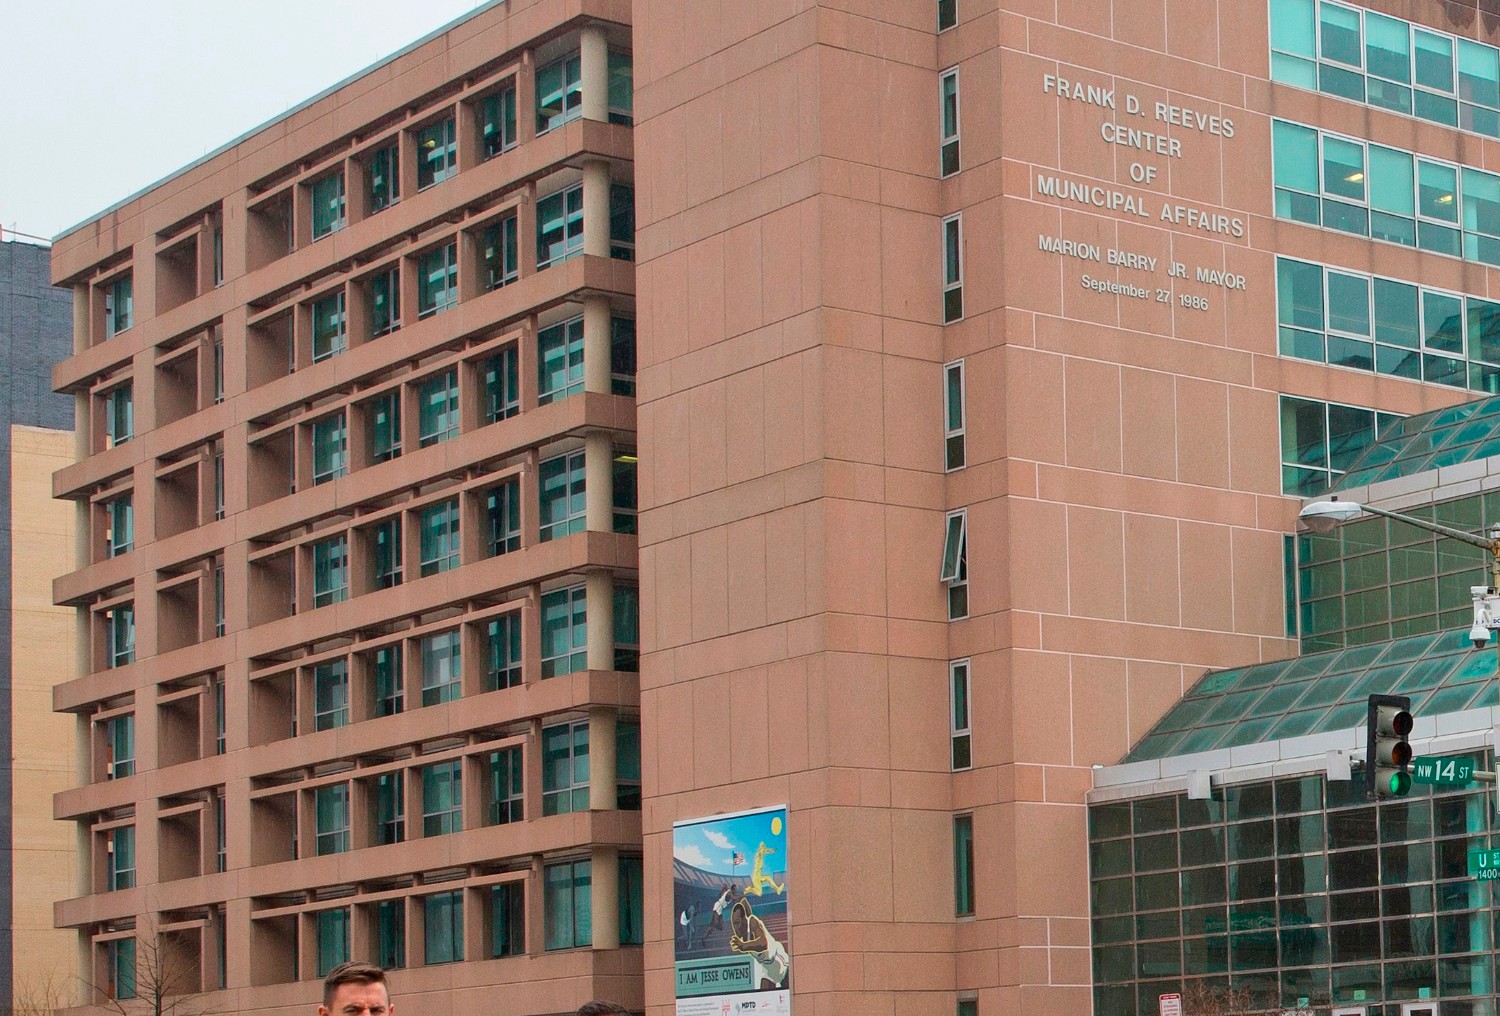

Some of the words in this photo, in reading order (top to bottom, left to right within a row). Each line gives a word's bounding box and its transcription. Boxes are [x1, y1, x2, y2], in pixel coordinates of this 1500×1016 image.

[1044, 73, 1116, 109] FRANK
[1126, 95, 1146, 117] D.
[1155, 102, 1235, 138] REEVES
[1101, 122, 1182, 158] CENTER
[1130, 162, 1157, 184] OF
[1037, 174, 1150, 217] MUNICIPAL
[1160, 204, 1244, 238] AFFAIRS
[1038, 234, 1100, 262] MARION
[1107, 248, 1157, 272] BARRY
[1168, 261, 1190, 280] JR.
[1196, 266, 1246, 290] MAYOR
[1081, 275, 1150, 299] September
[1179, 293, 1209, 311] 1986
[1417, 765, 1432, 778] NW
[1435, 760, 1456, 782] 14
[1459, 766, 1470, 779] ST
[1478, 853, 1487, 868] U
[1479, 868, 1498, 879] 1400
[680, 974, 683, 985] I
[686, 973, 698, 984] AM
[701, 970, 719, 985] JESSE
[722, 967, 749, 981] OWENS
